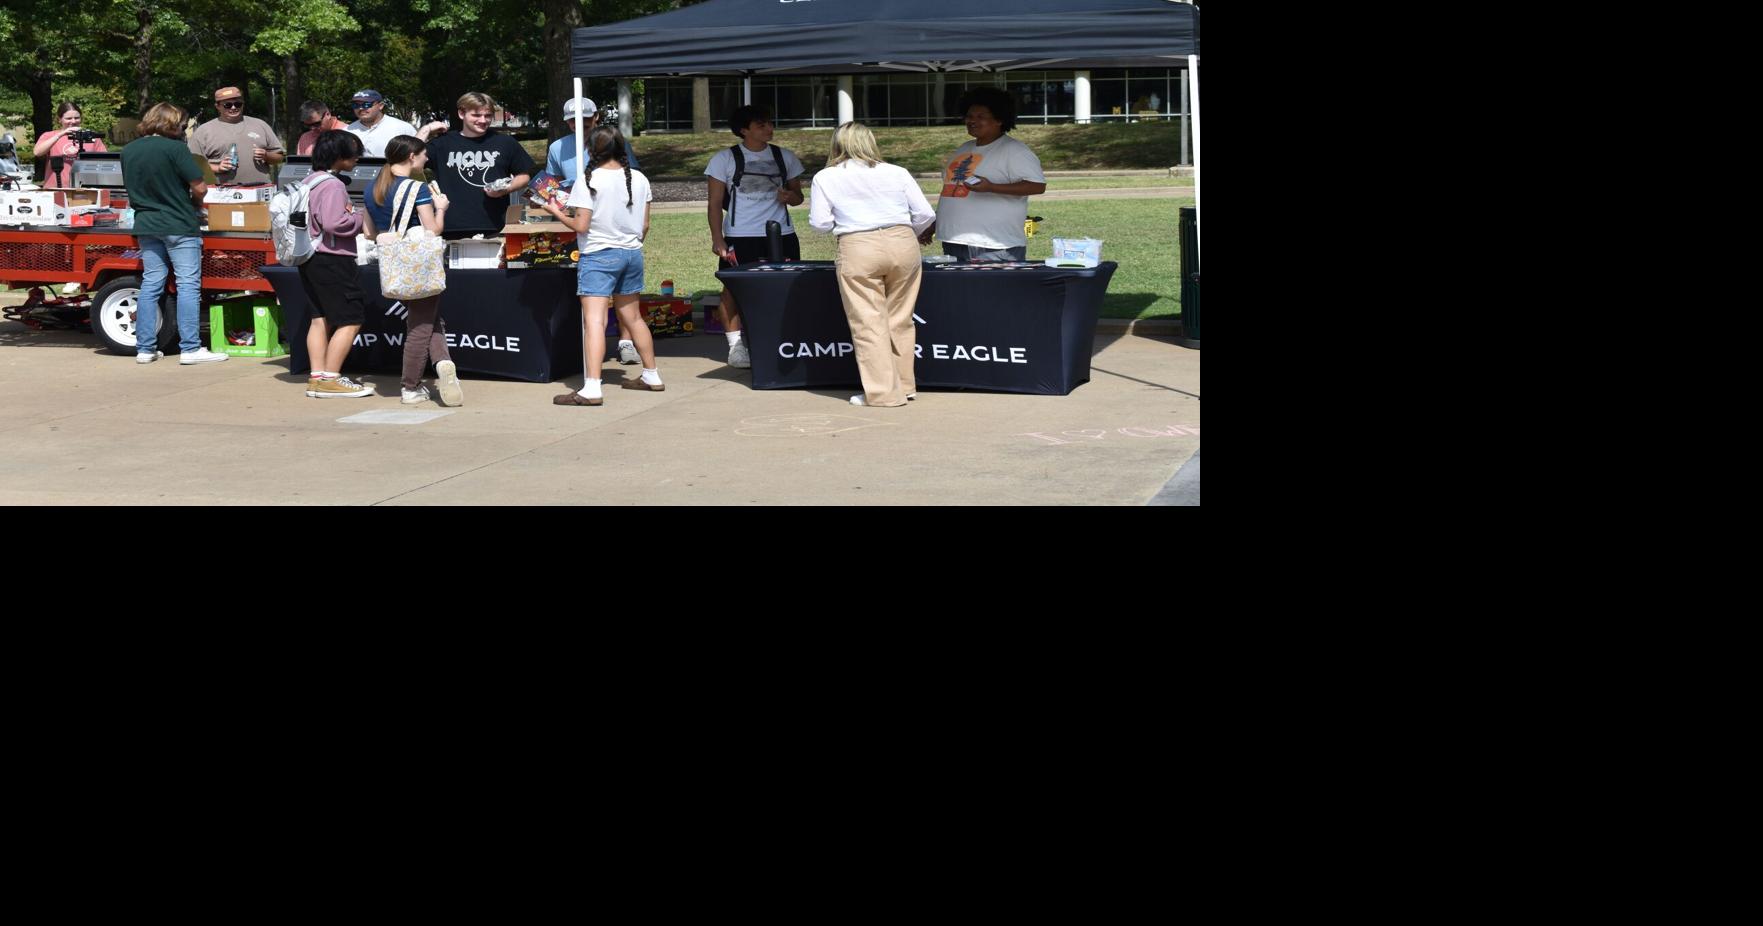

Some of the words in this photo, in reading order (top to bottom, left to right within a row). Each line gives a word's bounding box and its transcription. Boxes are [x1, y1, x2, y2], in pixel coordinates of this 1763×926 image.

[447, 150, 500, 168] HOLY
[444, 333, 521, 353] EAGLE
[778, 342, 854, 358] CAMP
[932, 344, 1028, 364] EAGLE
